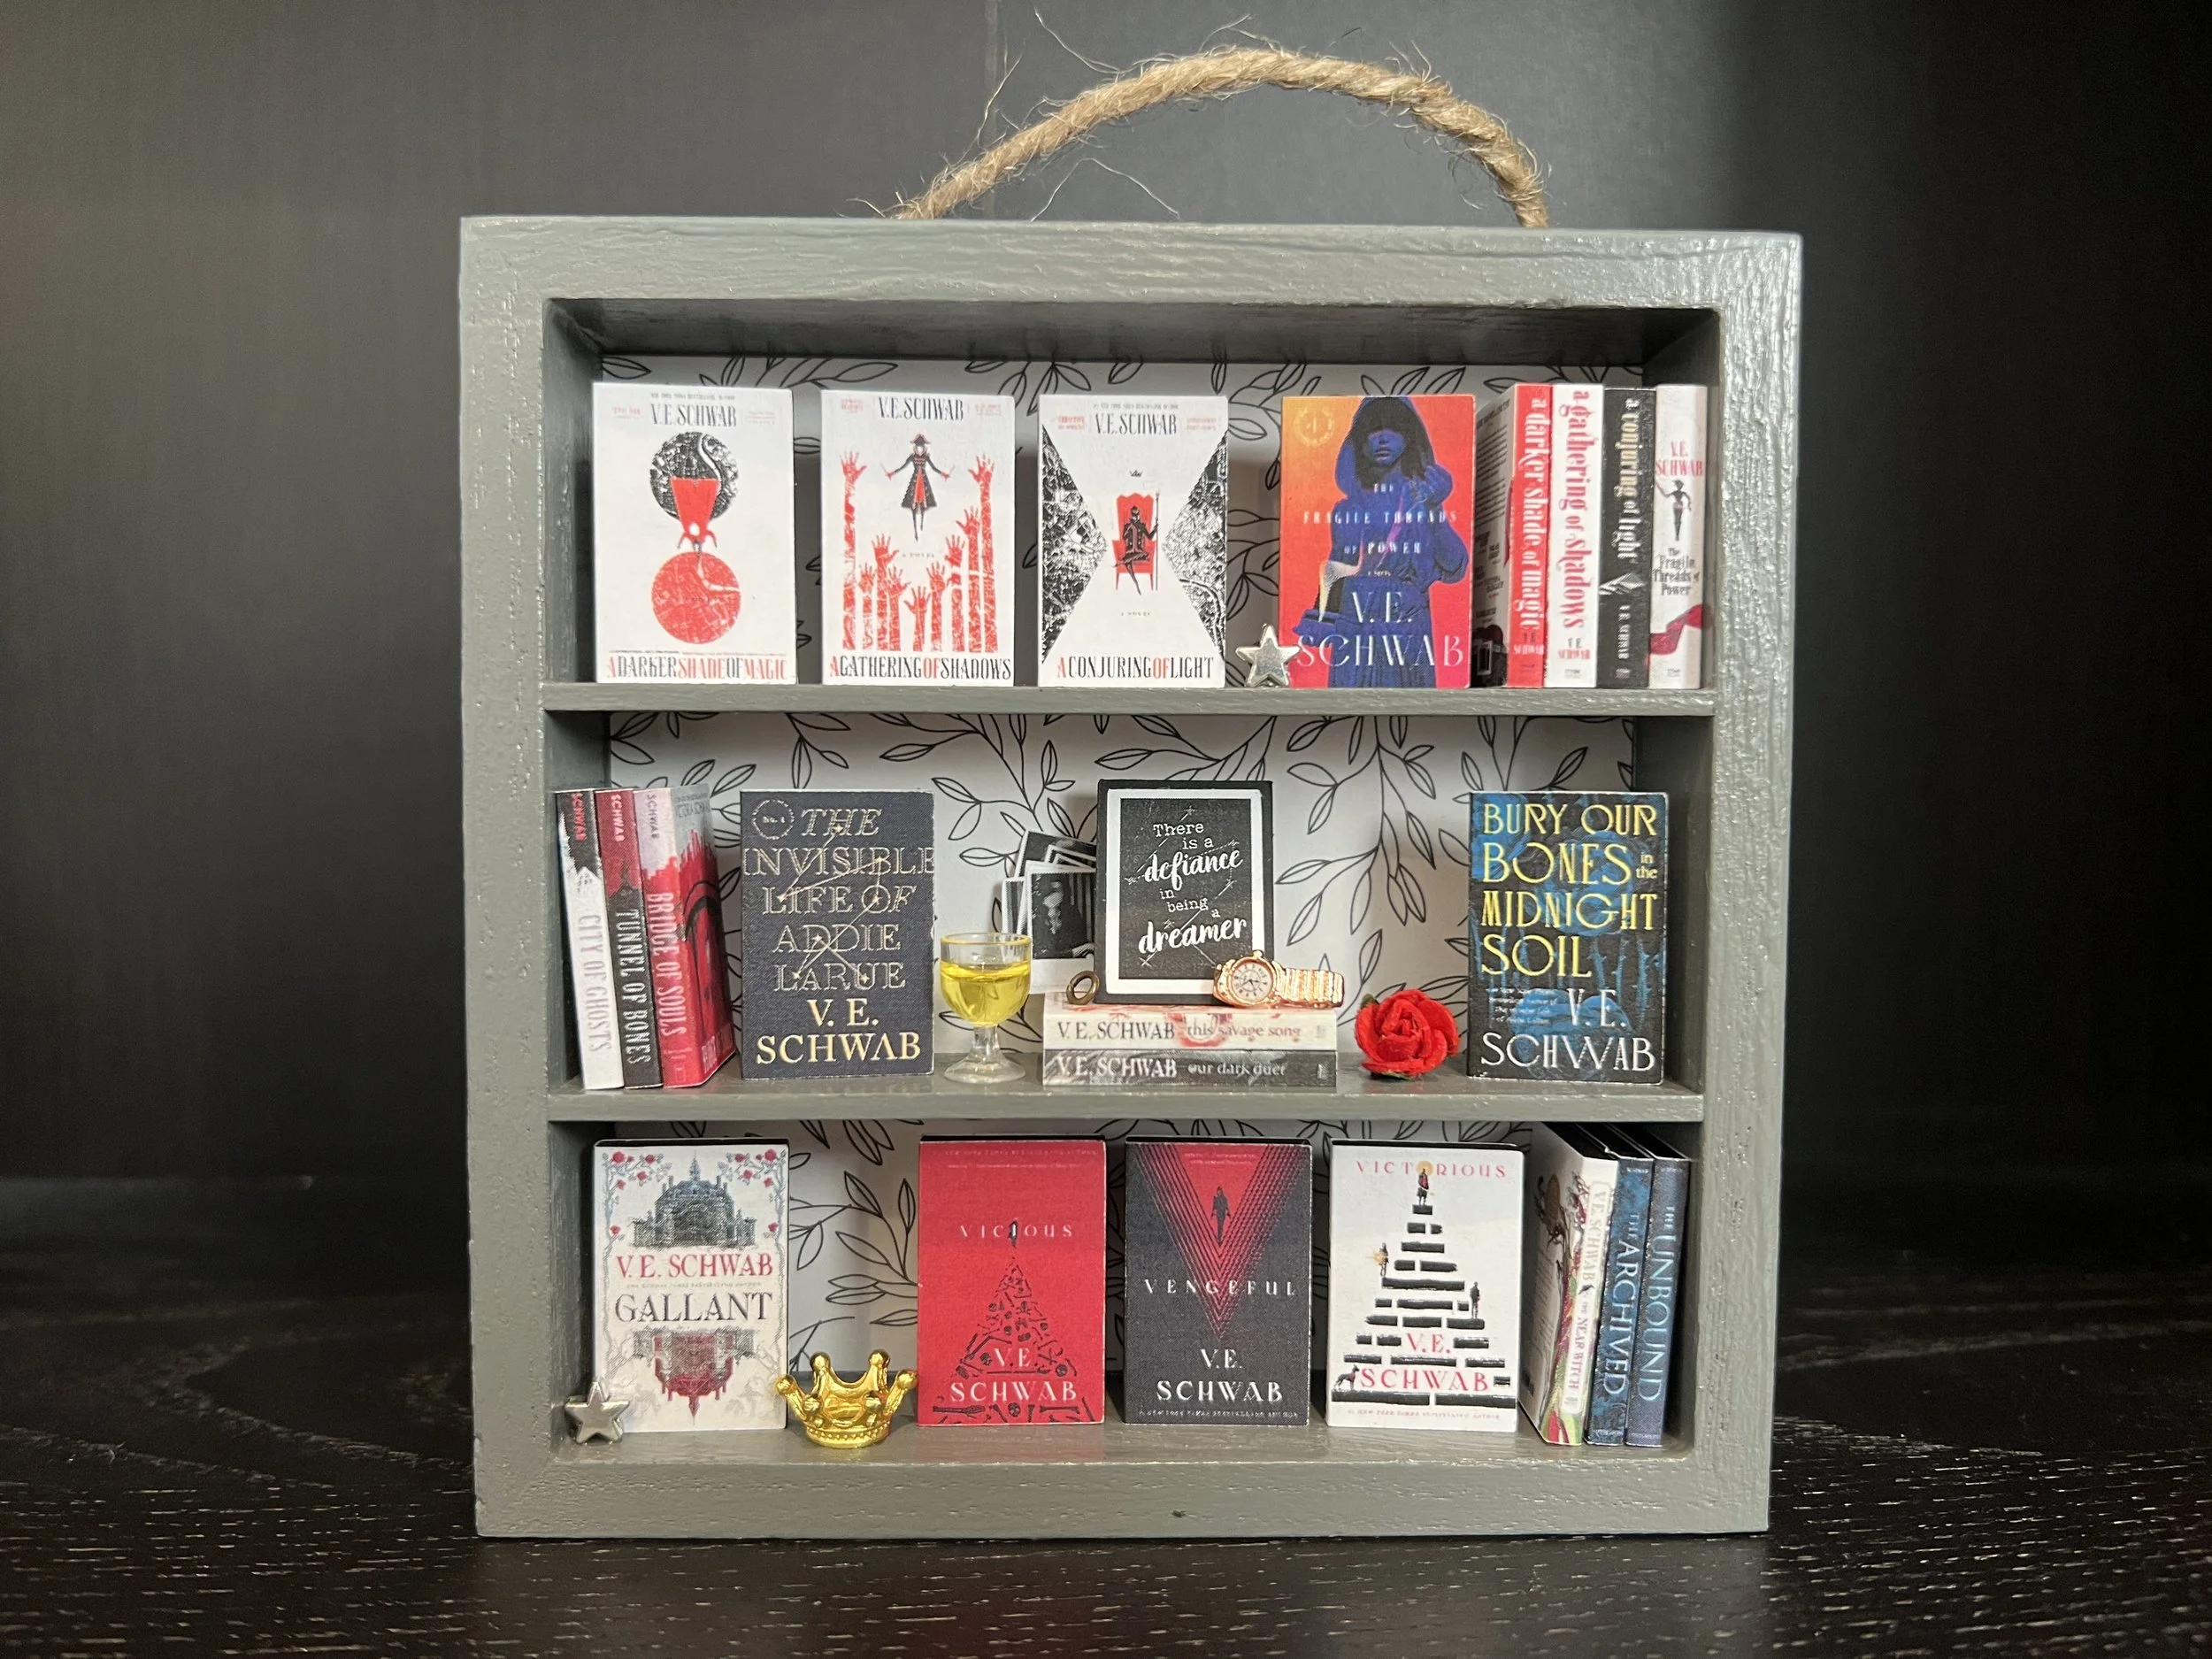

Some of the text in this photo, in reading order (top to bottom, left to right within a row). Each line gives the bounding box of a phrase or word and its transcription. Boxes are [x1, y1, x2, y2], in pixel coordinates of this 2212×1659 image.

[1518, 413, 1550, 480] darker
[1559, 403, 1599, 511] gathering
[1523, 488, 1548, 546] shade
[1565, 515, 1581, 529] of
[1368, 541, 1422, 555] POWER
[1522, 551, 1541, 567] of
[1555, 534, 1592, 629] shadows
[1513, 570, 1545, 630] magic
[1295, 634, 1463, 666] SCHWAB
[647, 794, 660, 839] SCHWAB
[800, 808, 883, 837] THE
[1153, 822, 1204, 838] There
[1483, 803, 1657, 836] BURY OUR
[1182, 837, 1215, 850] is a
[1640, 851, 1654, 864] in
[743, 847, 934, 877] INVISIBLE
[1144, 850, 1244, 891] defiance
[1483, 841, 1632, 886] BONES
[1635, 865, 1658, 879] the
[762, 885, 918, 916] LIFE OF
[1160, 888, 1175, 900] in
[1167, 897, 1209, 913] being
[647, 893, 680, 956] BRIDGE
[1211, 908, 1221, 918] a
[1480, 890, 1658, 930] MIDNIGHT
[578, 915, 604, 953] CITY
[611, 794, 652, 1064] SCHWAB TUNNEL OF BONES
[772, 923, 902, 954] ADDIE
[1138, 918, 1248, 954] dreamer
[582, 960, 608, 980] OF
[656, 961, 682, 980] OF
[1481, 933, 1592, 977] SOIL
[585, 986, 613, 1052] GHOSTS
[656, 985, 687, 1036] SOULS
[1097, 1021, 1175, 1041] SCHWAB
[1187, 1021, 1214, 1037] this
[1217, 1025, 1264, 1042] savage
[1268, 1026, 1301, 1042] song
[756, 1031, 921, 1064] SCHWAB
[1480, 1032, 1655, 1071] SCHWAB
[1096, 1057, 1178, 1079] SCHWAB
[959, 1224, 1073, 1239] VICIOUS
[669, 1252, 773, 1279] SCHWAB
[1144, 1279, 1297, 1296] VENGEFUL
[615, 1291, 773, 1322] GALLANT
[1602, 1213, 1640, 1394] THE ARCHIVED
[1639, 1206, 1678, 1402] THE UNBOUND
[950, 1380, 1077, 1402] SCHWAB
[1156, 1379, 1283, 1402] SCHWAB
[1360, 1368, 1489, 1392] SCHWAB
